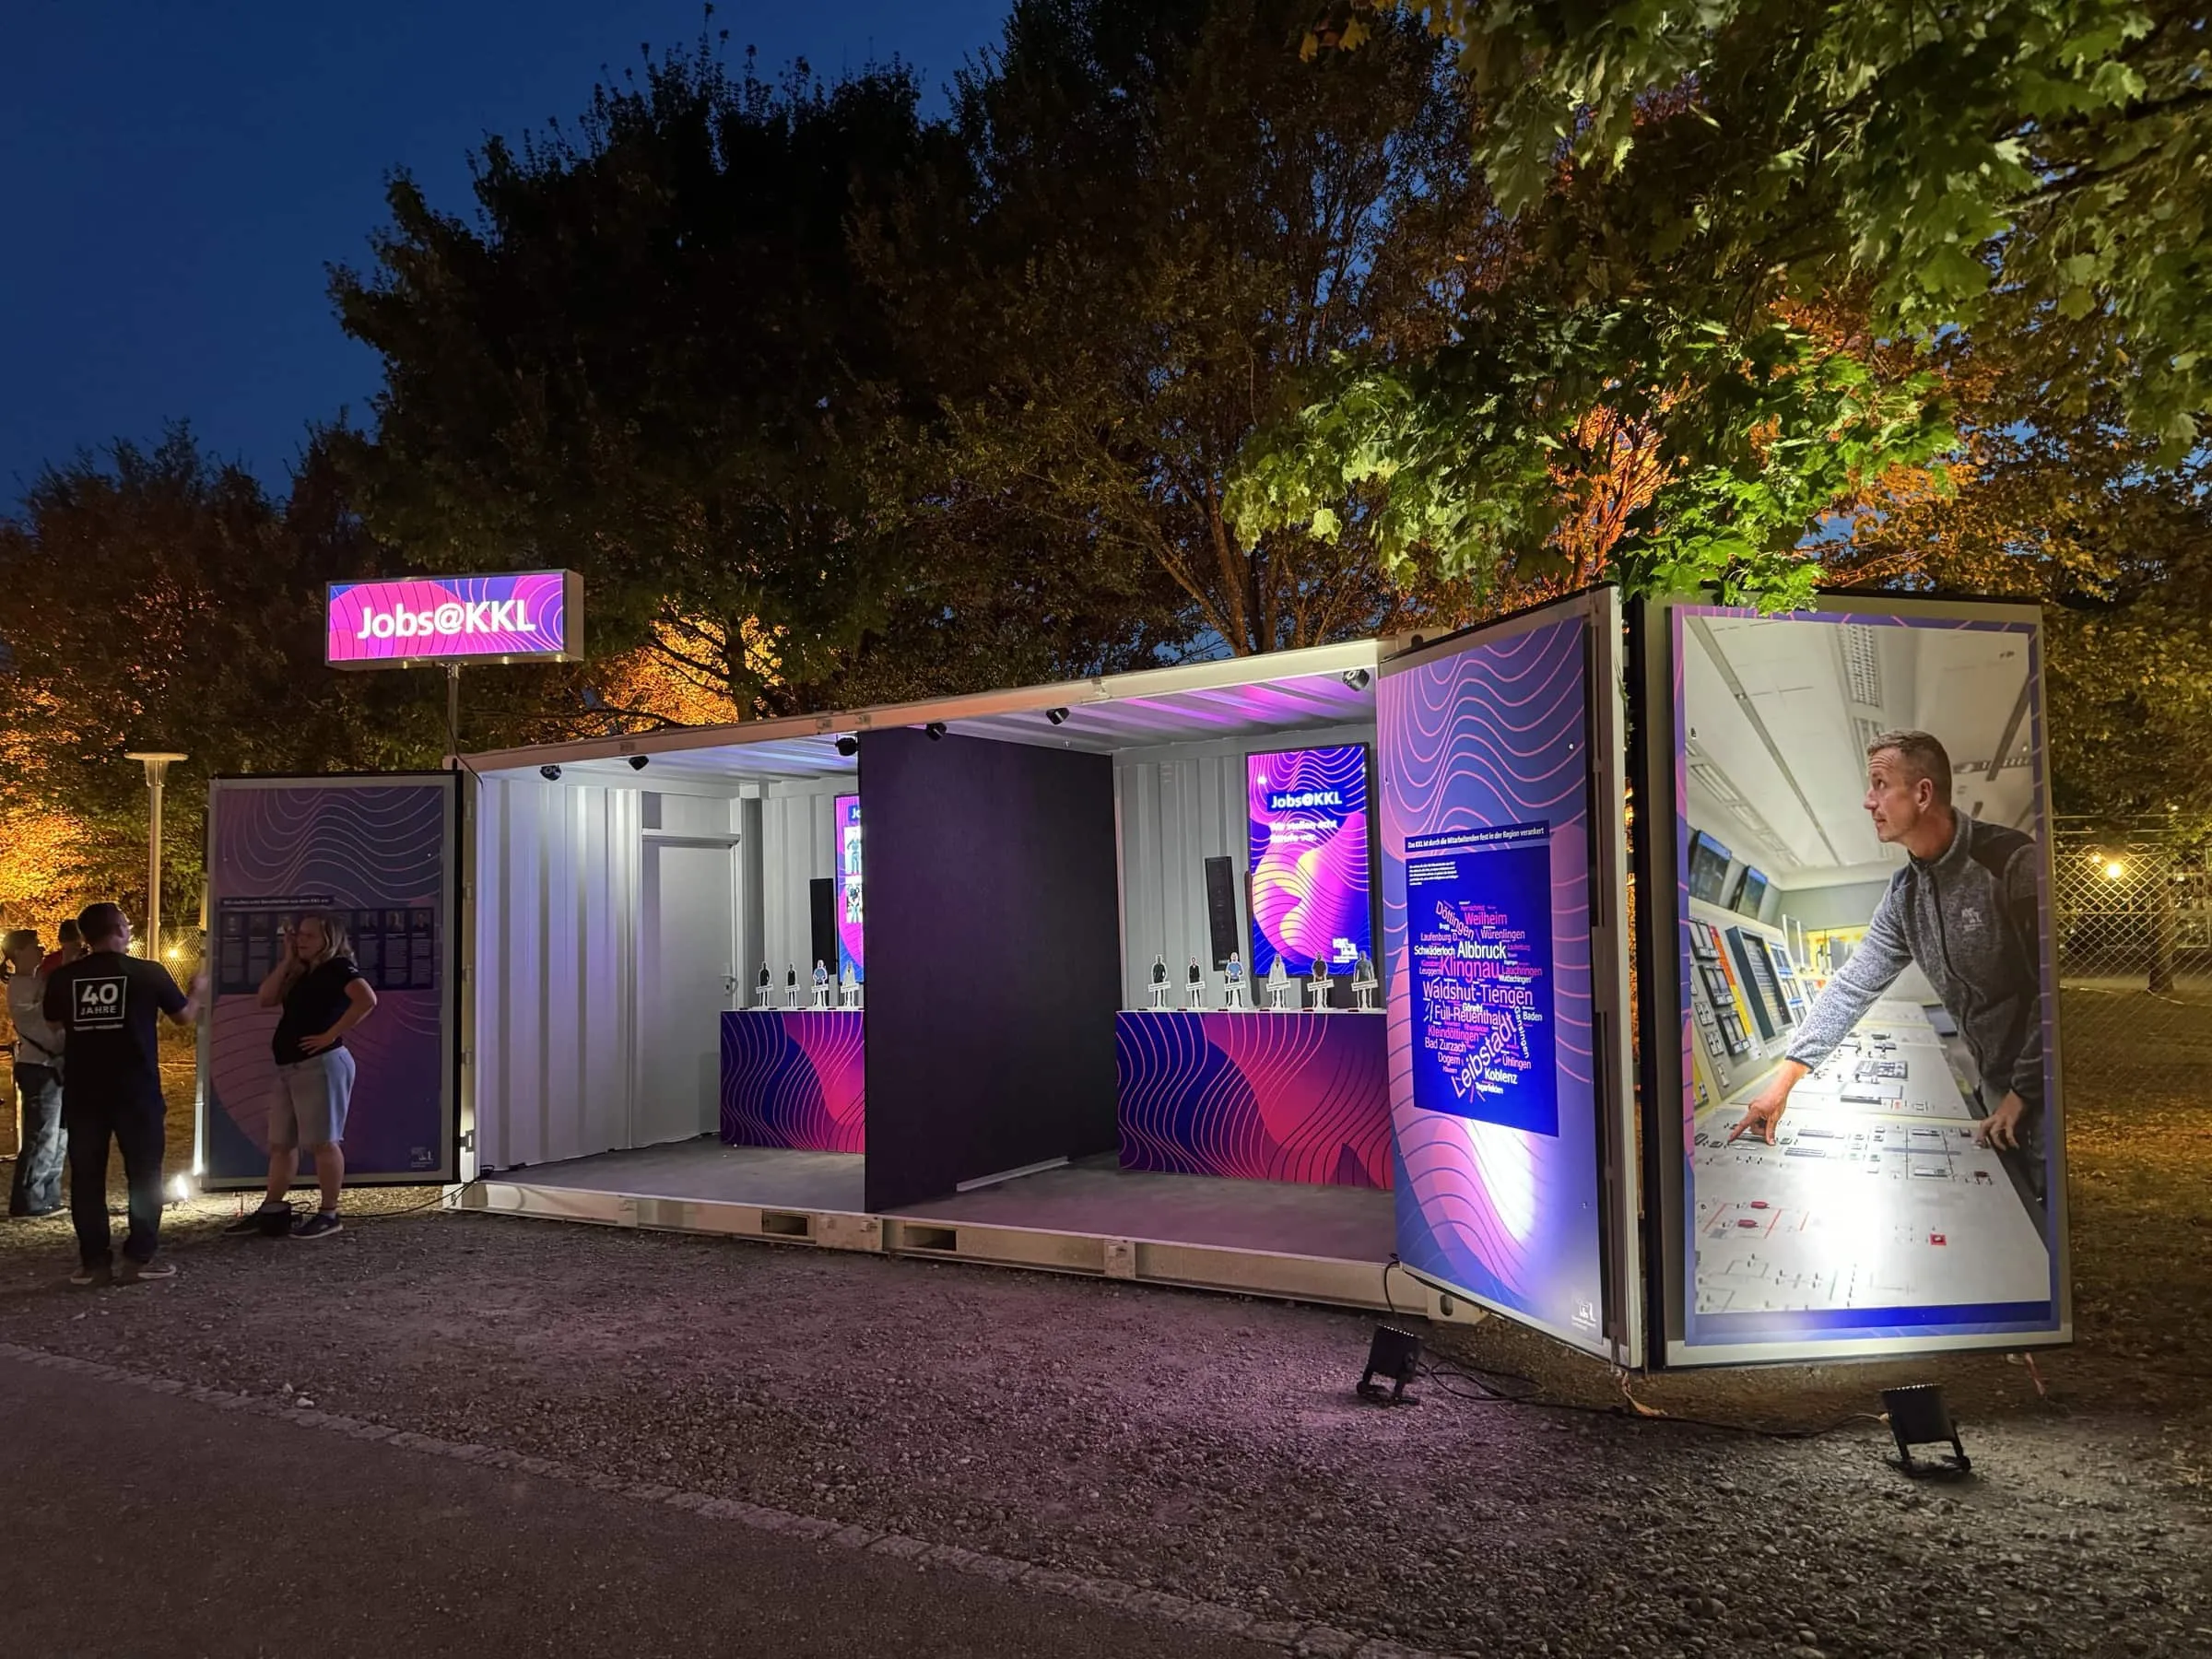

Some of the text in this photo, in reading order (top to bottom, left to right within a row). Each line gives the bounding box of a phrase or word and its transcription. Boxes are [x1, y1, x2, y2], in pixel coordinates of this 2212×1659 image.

[358, 599, 535, 639] Jobs@KKL
[1271, 791, 1343, 808] Jobs@KKL
[1429, 838, 1440, 846] durch
[1447, 833, 1479, 844] Mitarbeitenden
[1480, 832, 1488, 841] fest
[1489, 831, 1494, 840] in
[1494, 830, 1502, 840] der
[1503, 830, 1520, 839] Region
[1520, 827, 1545, 836] verankert
[1436, 900, 1475, 941] Döttingen
[1464, 912, 1508, 925] Weilheim
[1420, 932, 1452, 944] Laufenburg
[1480, 928, 1525, 942] Würenlingen
[1456, 940, 1508, 959] Albbruck
[1440, 956, 1500, 983] Klingnau
[1502, 965, 1543, 978] Lauchringen
[81, 983, 118, 1006] 40
[1422, 980, 1533, 1009] Waldshut-Tiengen
[80, 1006, 118, 1016] JAHRE
[1434, 1005, 1501, 1026] Full-Reuenthal
[1523, 1011, 1543, 1022] Baden
[1428, 1025, 1479, 1044] Kleindöttingen
[1425, 1037, 1466, 1053] Bad Zurzach
[1451, 1010, 1517, 1099] Leibstadt
[1484, 1067, 1519, 1085] Koblenz
